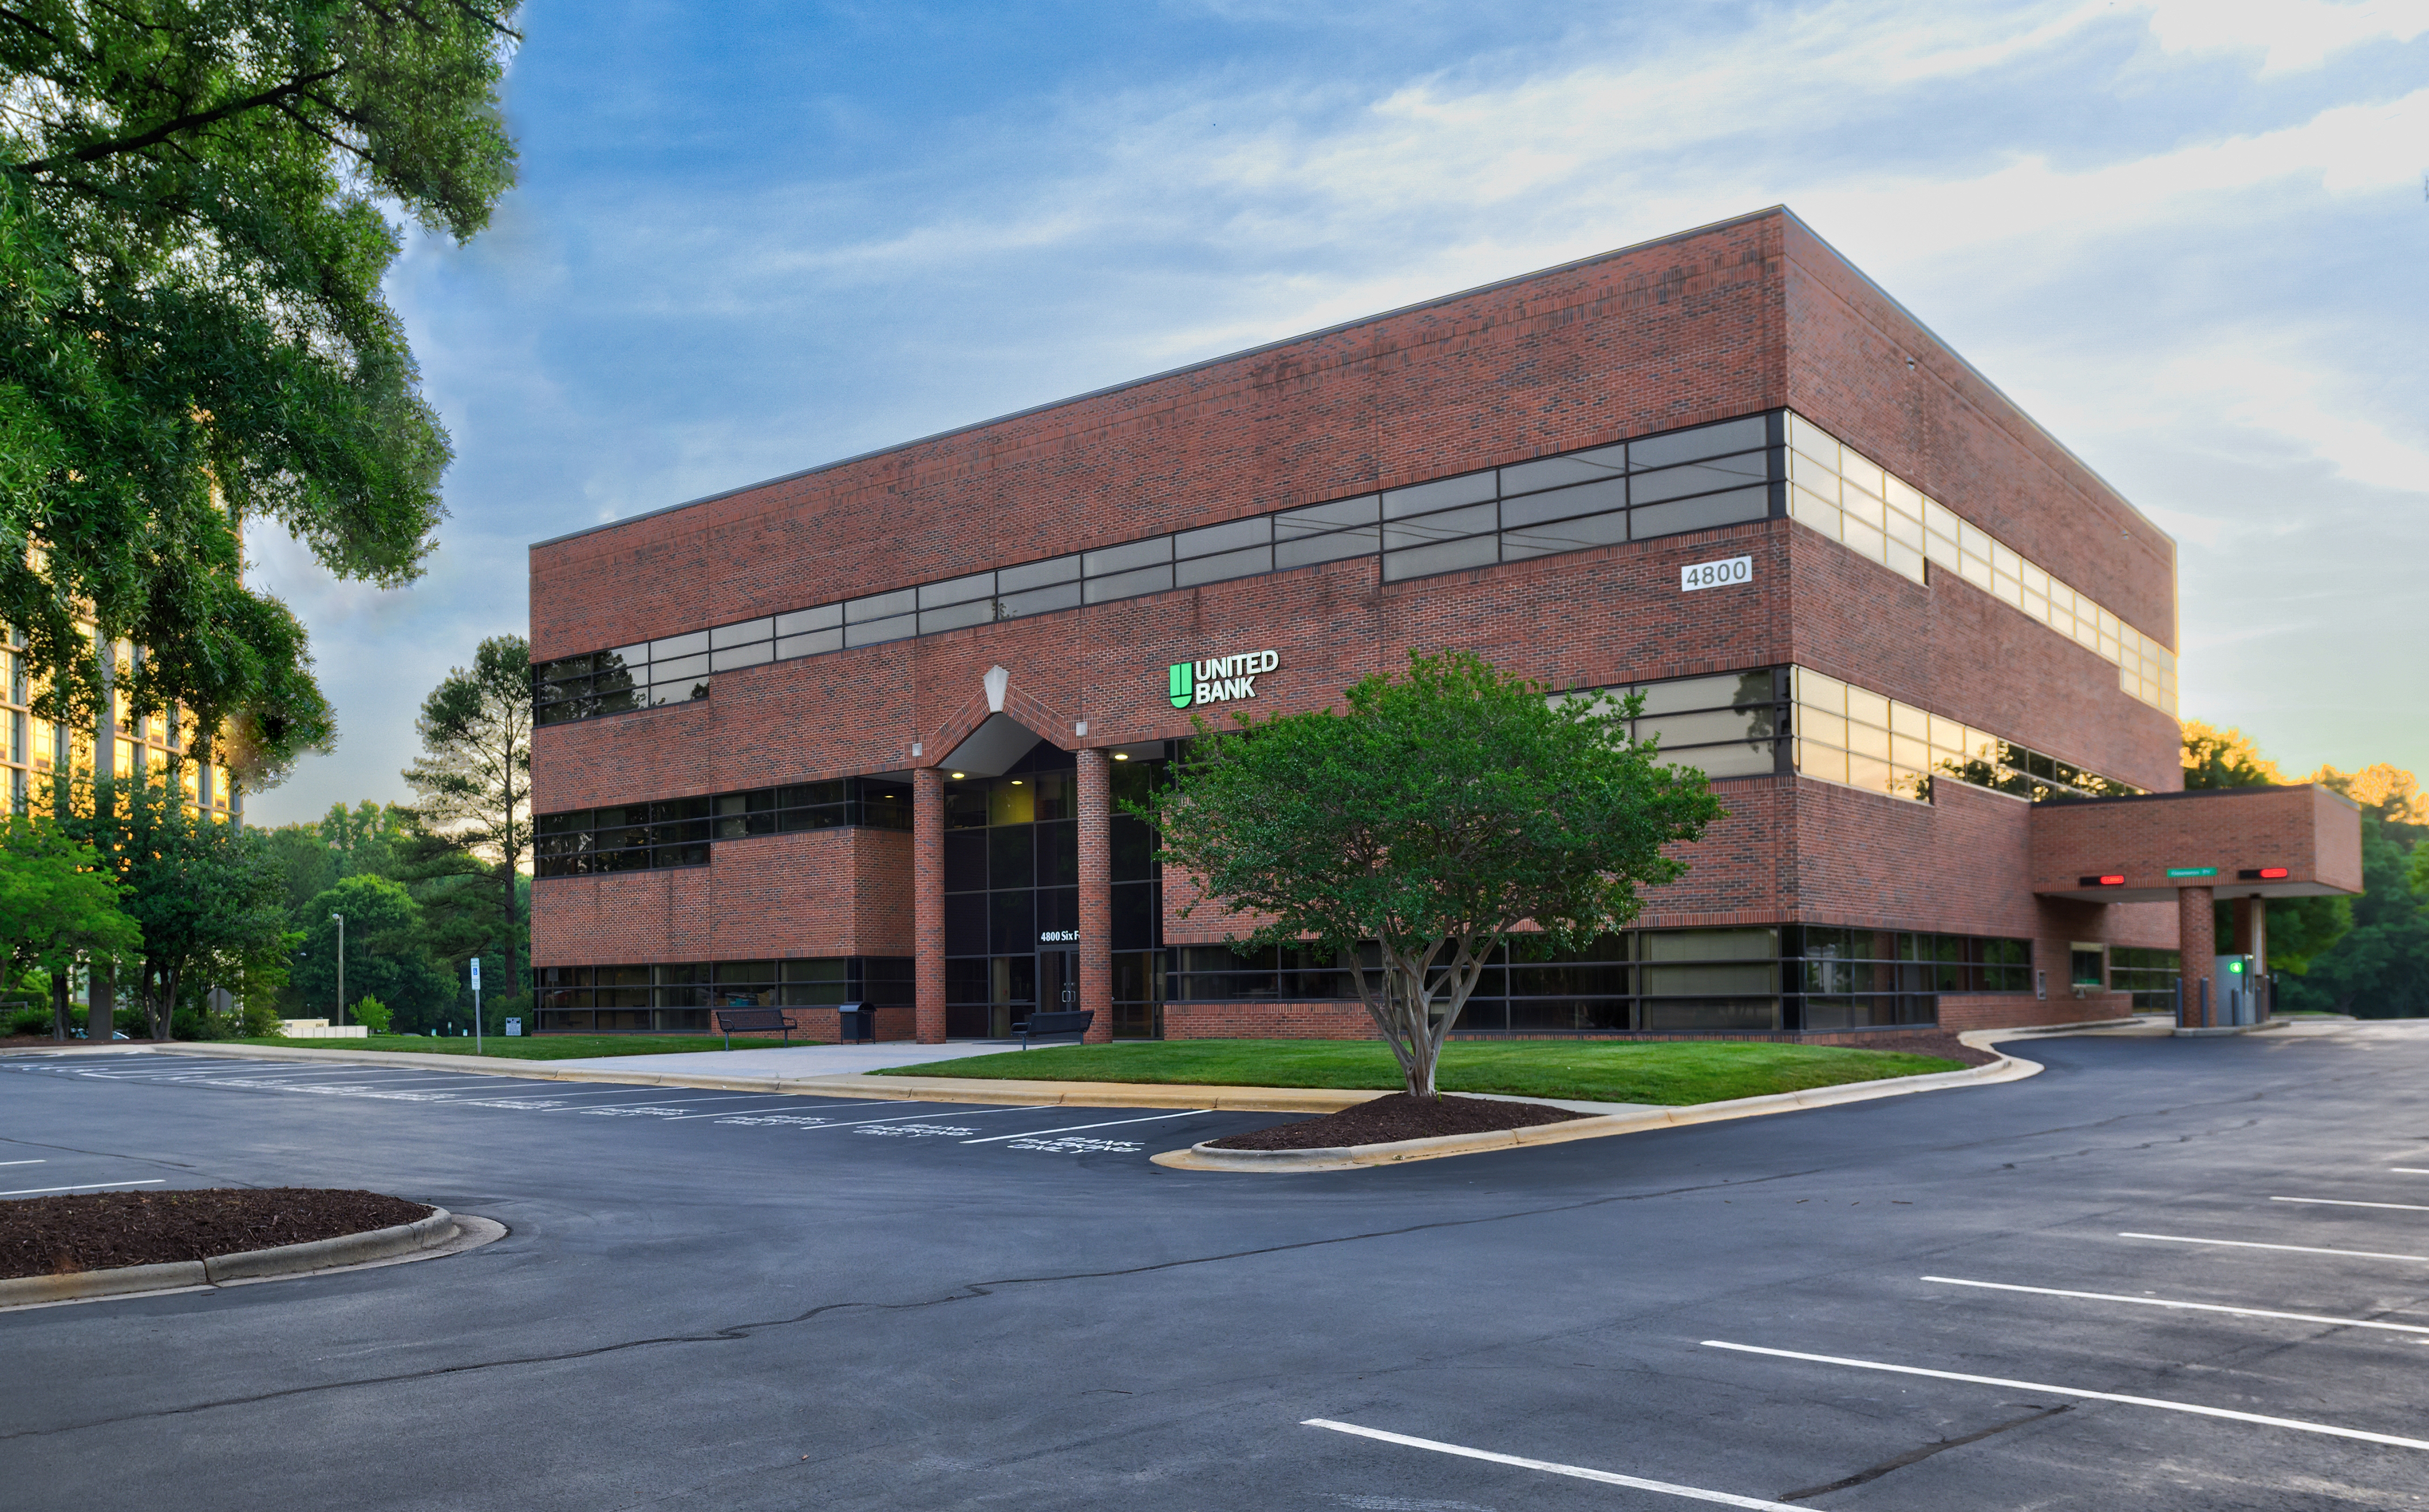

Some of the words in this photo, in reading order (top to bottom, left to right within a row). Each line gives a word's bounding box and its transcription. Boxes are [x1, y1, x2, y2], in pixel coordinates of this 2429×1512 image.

[1686, 560, 1747, 586] 4800
[1195, 649, 1279, 681] UNITED
[1195, 675, 1257, 704] BANK
[1041, 931, 1061, 941] 4800
[1061, 930, 1074, 941] Six
